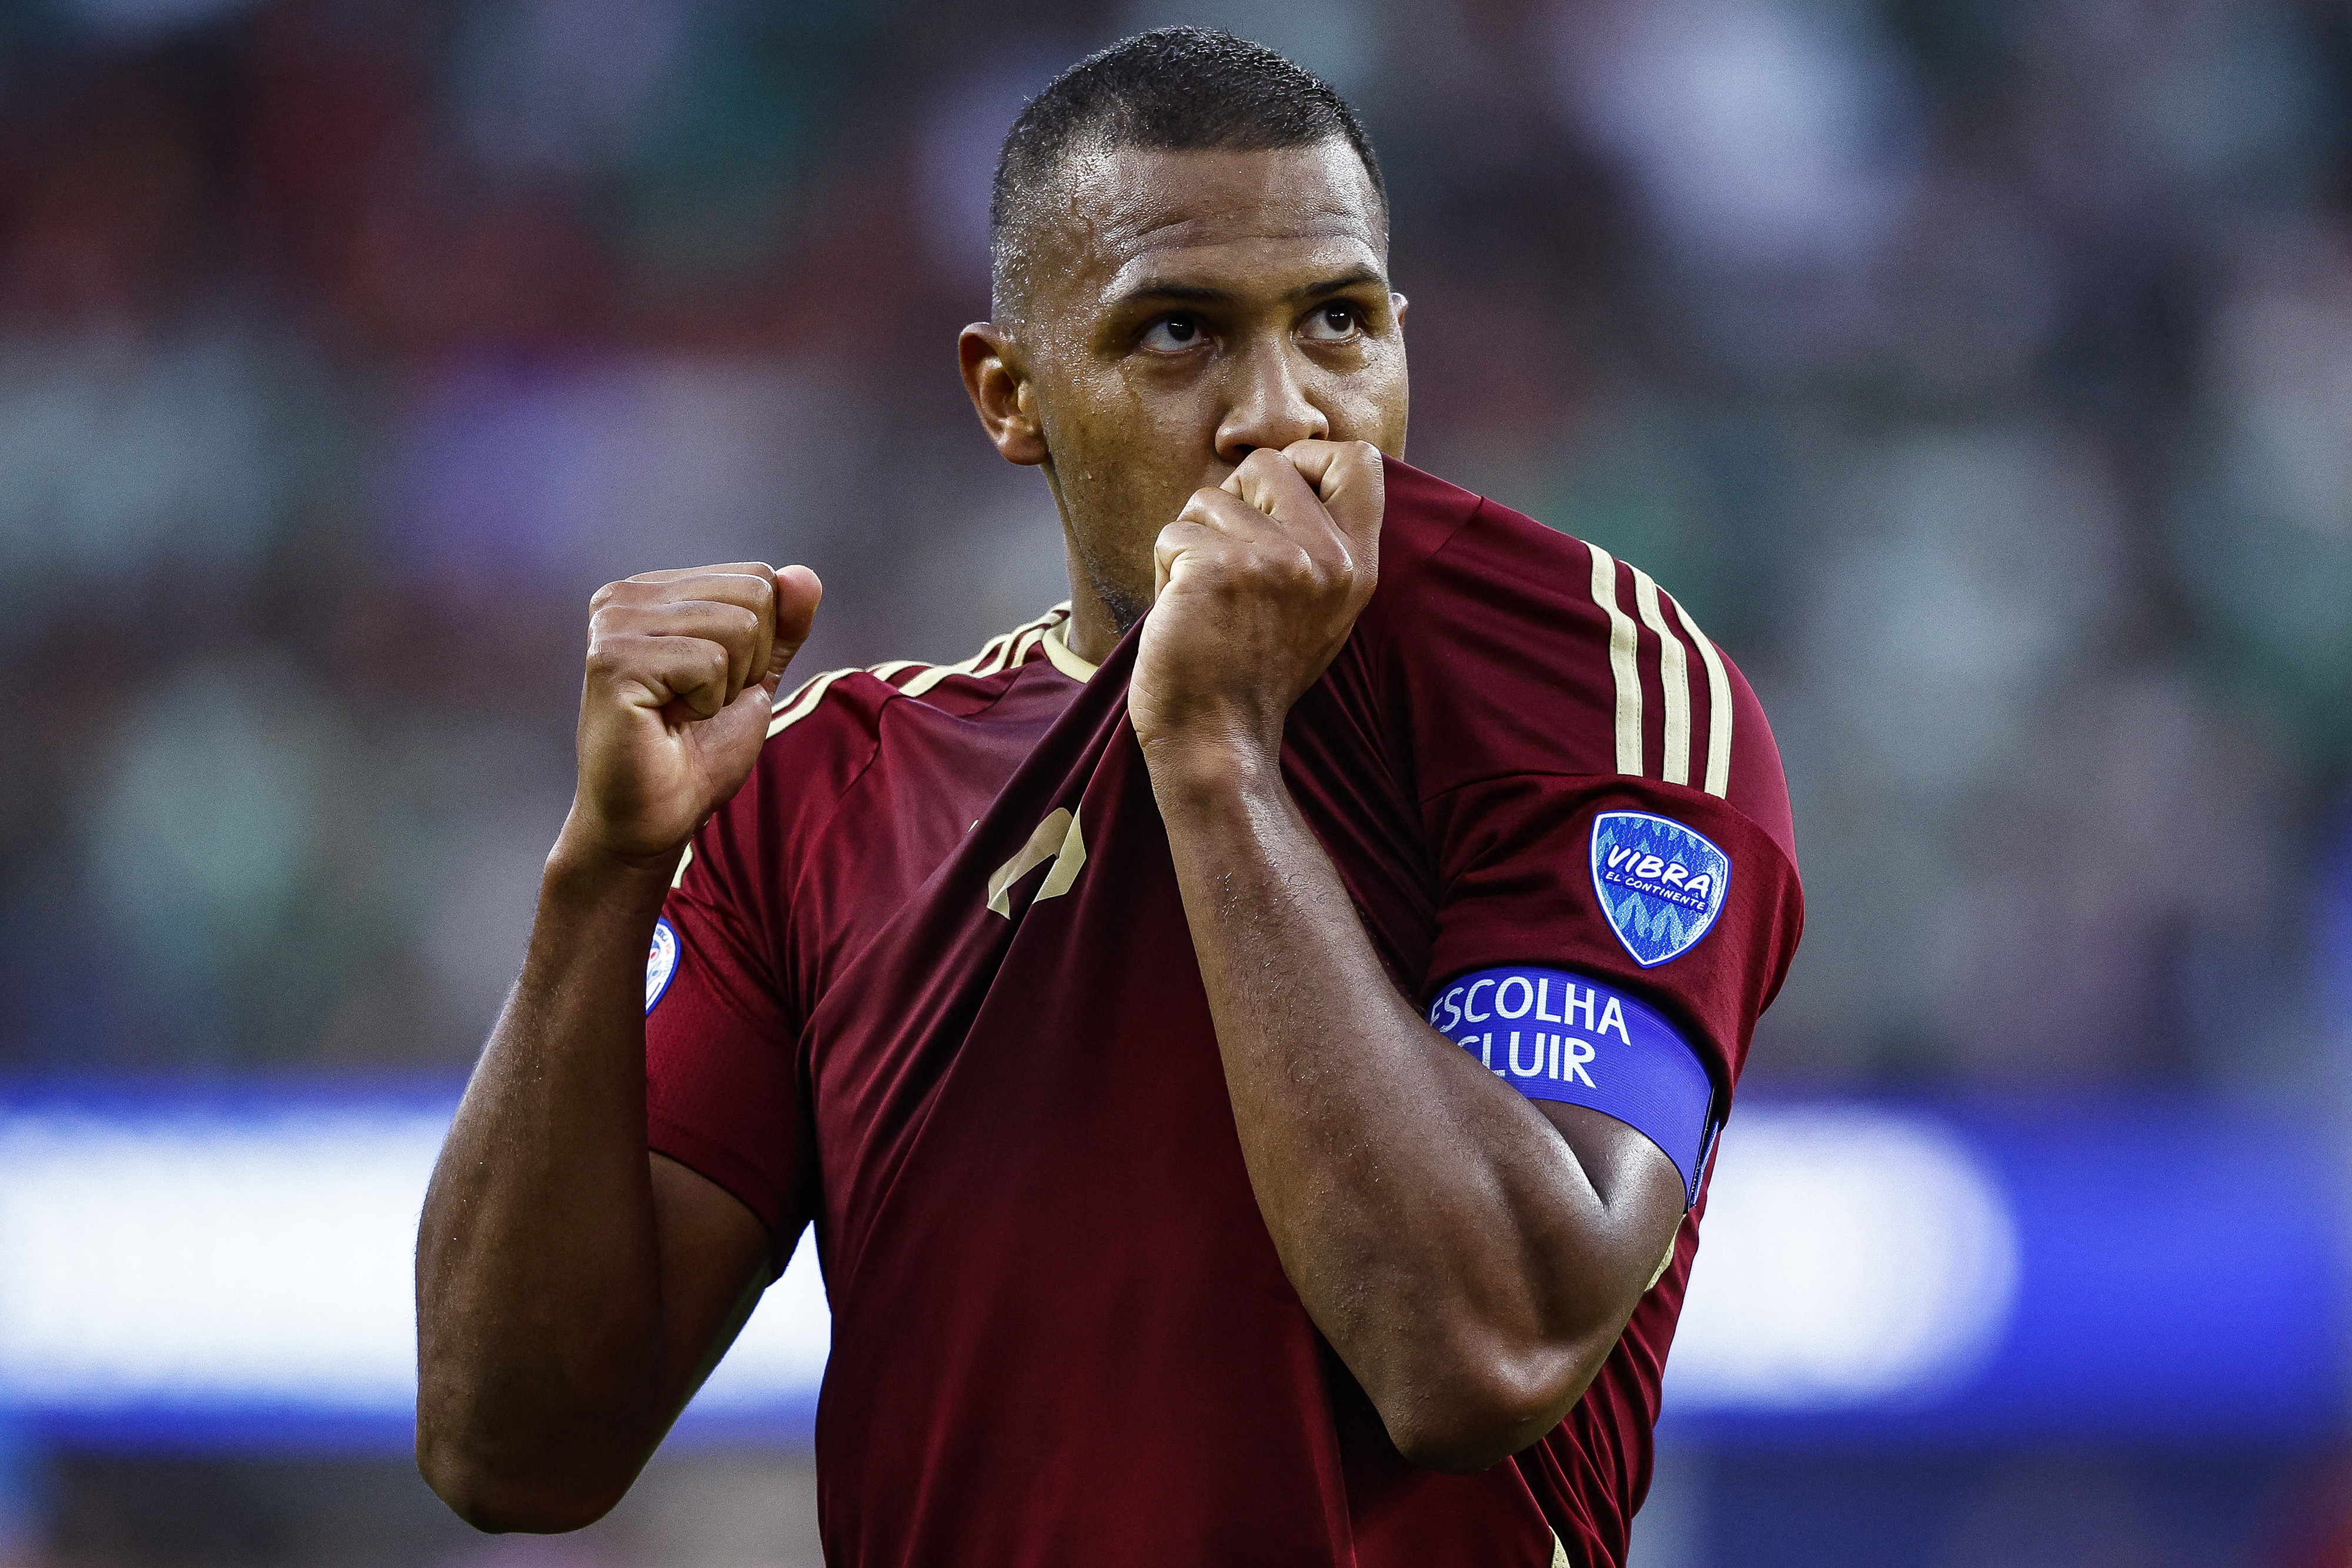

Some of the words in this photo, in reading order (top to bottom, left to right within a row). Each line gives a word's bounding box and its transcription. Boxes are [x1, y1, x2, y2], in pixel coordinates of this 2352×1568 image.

[1605, 871, 1621, 882] EL
[1625, 877, 1706, 911] CONTINENTE
[1608, 845, 1711, 899] VIBRA
[1429, 976, 1632, 1047] ESCOLHA
